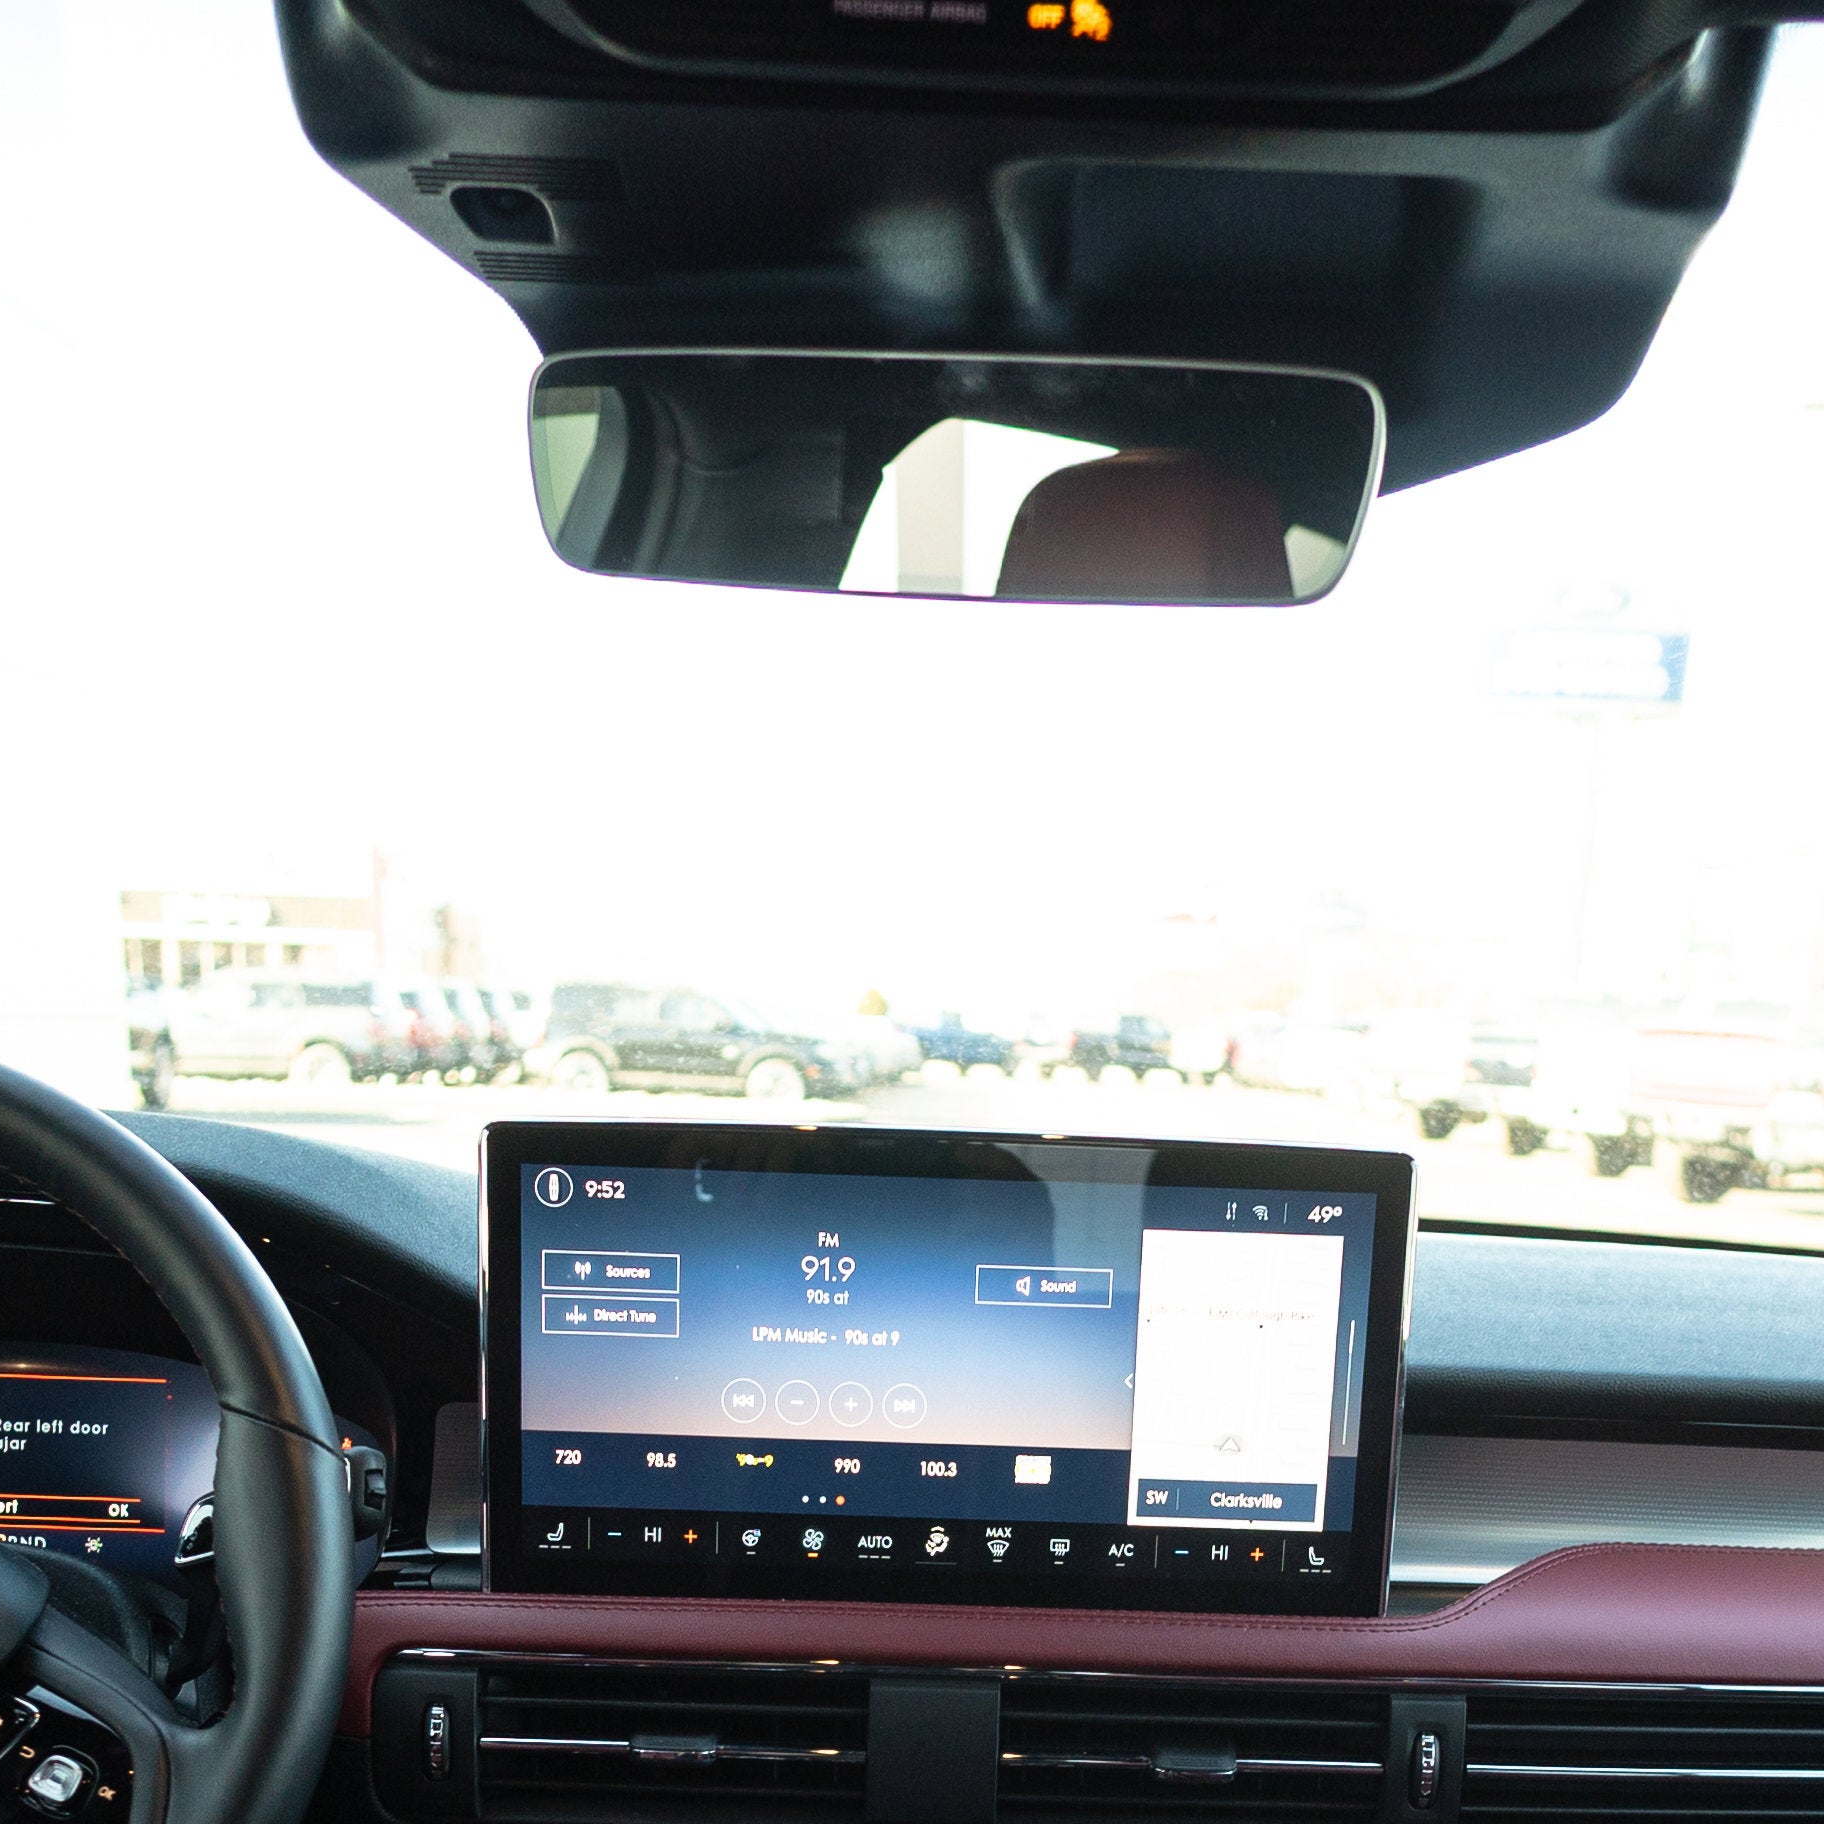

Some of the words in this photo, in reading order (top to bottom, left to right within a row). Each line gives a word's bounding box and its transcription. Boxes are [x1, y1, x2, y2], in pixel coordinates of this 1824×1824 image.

[584, 1180, 626, 1199] 9:52
[817, 1232, 840, 1248] FM
[605, 1264, 651, 1279] Sources
[800, 1255, 856, 1282] 91.9
[1040, 1279, 1077, 1294] Sound
[805, 1289, 830, 1305] 90s
[833, 1290, 850, 1305] at
[593, 1308, 628, 1322] Direct
[629, 1309, 657, 1324] Tune
[752, 1326, 782, 1343] LPM
[784, 1327, 828, 1344] Music
[844, 1329, 869, 1345] 90s
[871, 1330, 888, 1346] at
[890, 1331, 900, 1346] 9
[36, 1419, 63, 1434] left
[69, 1420, 109, 1436] door
[554, 1449, 582, 1465] 720
[646, 1452, 677, 1468] 98.5
[834, 1458, 861, 1474] 990
[920, 1460, 958, 1477] 100.3
[1145, 1489, 1169, 1505] SW
[1209, 1492, 1283, 1510] Clarksville
[107, 1503, 129, 1518] OK
[644, 1526, 662, 1543] HI
[985, 1527, 1012, 1539] MAX
[857, 1535, 893, 1549] AUTO
[1108, 1543, 1134, 1558] A/C
[1211, 1545, 1229, 1560] HI
